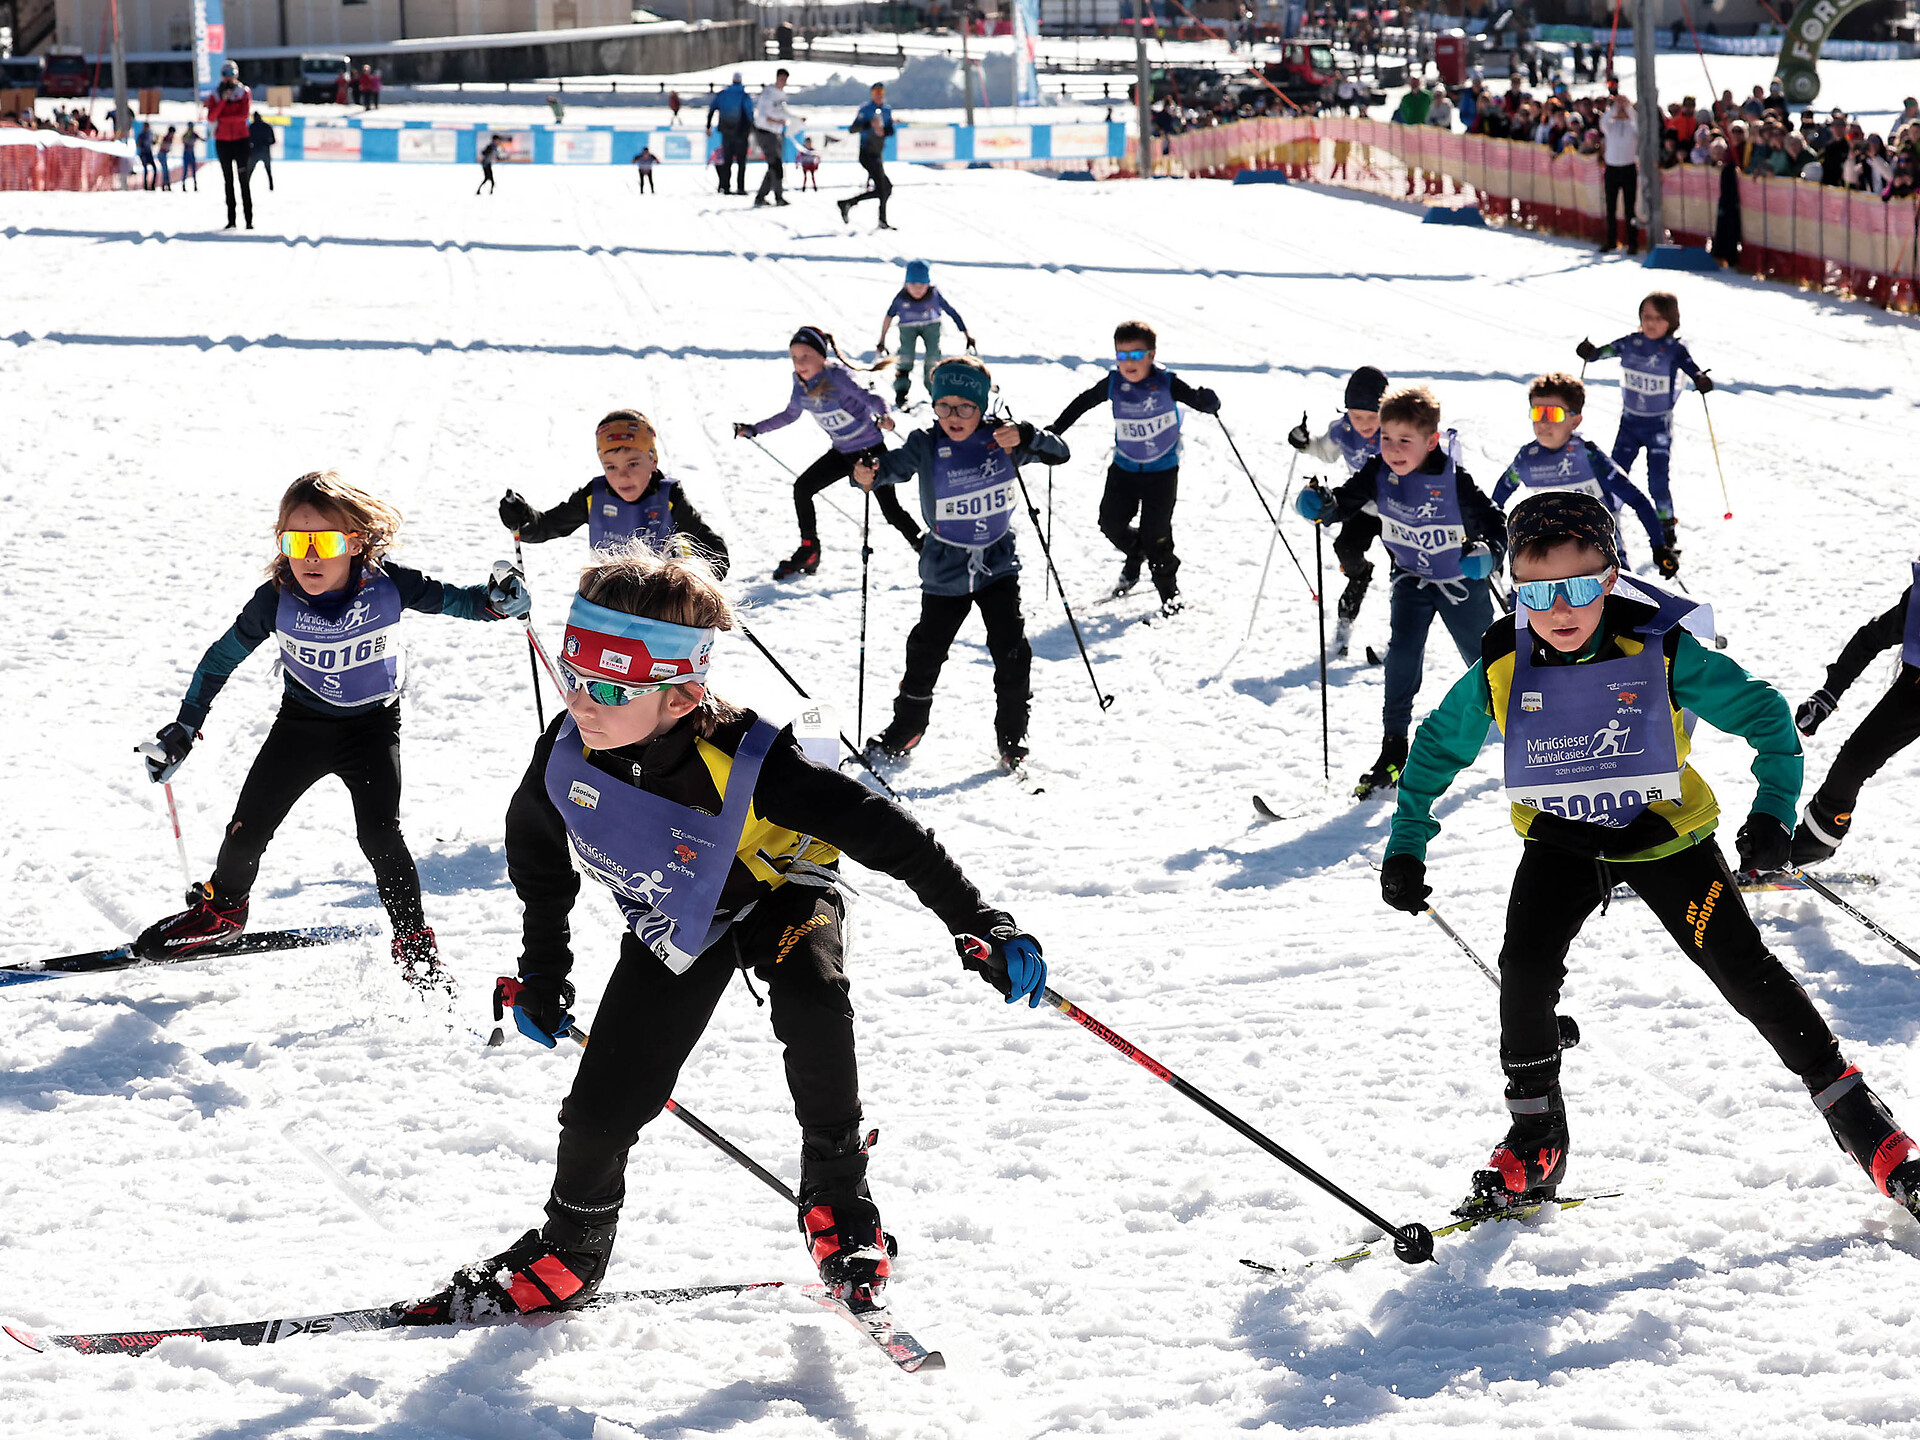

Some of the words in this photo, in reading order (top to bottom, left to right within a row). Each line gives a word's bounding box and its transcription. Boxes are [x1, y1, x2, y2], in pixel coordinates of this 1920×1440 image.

[1129, 418, 1163, 437] 5017
[957, 489, 1006, 515] 5015
[1397, 526, 1447, 550] 5020
[299, 640, 373, 669] 5016
[1527, 735, 1589, 752] MiniGsieser
[1528, 749, 1584, 764] MiniValCasies
[1694, 880, 1724, 949] KRONSPUR
